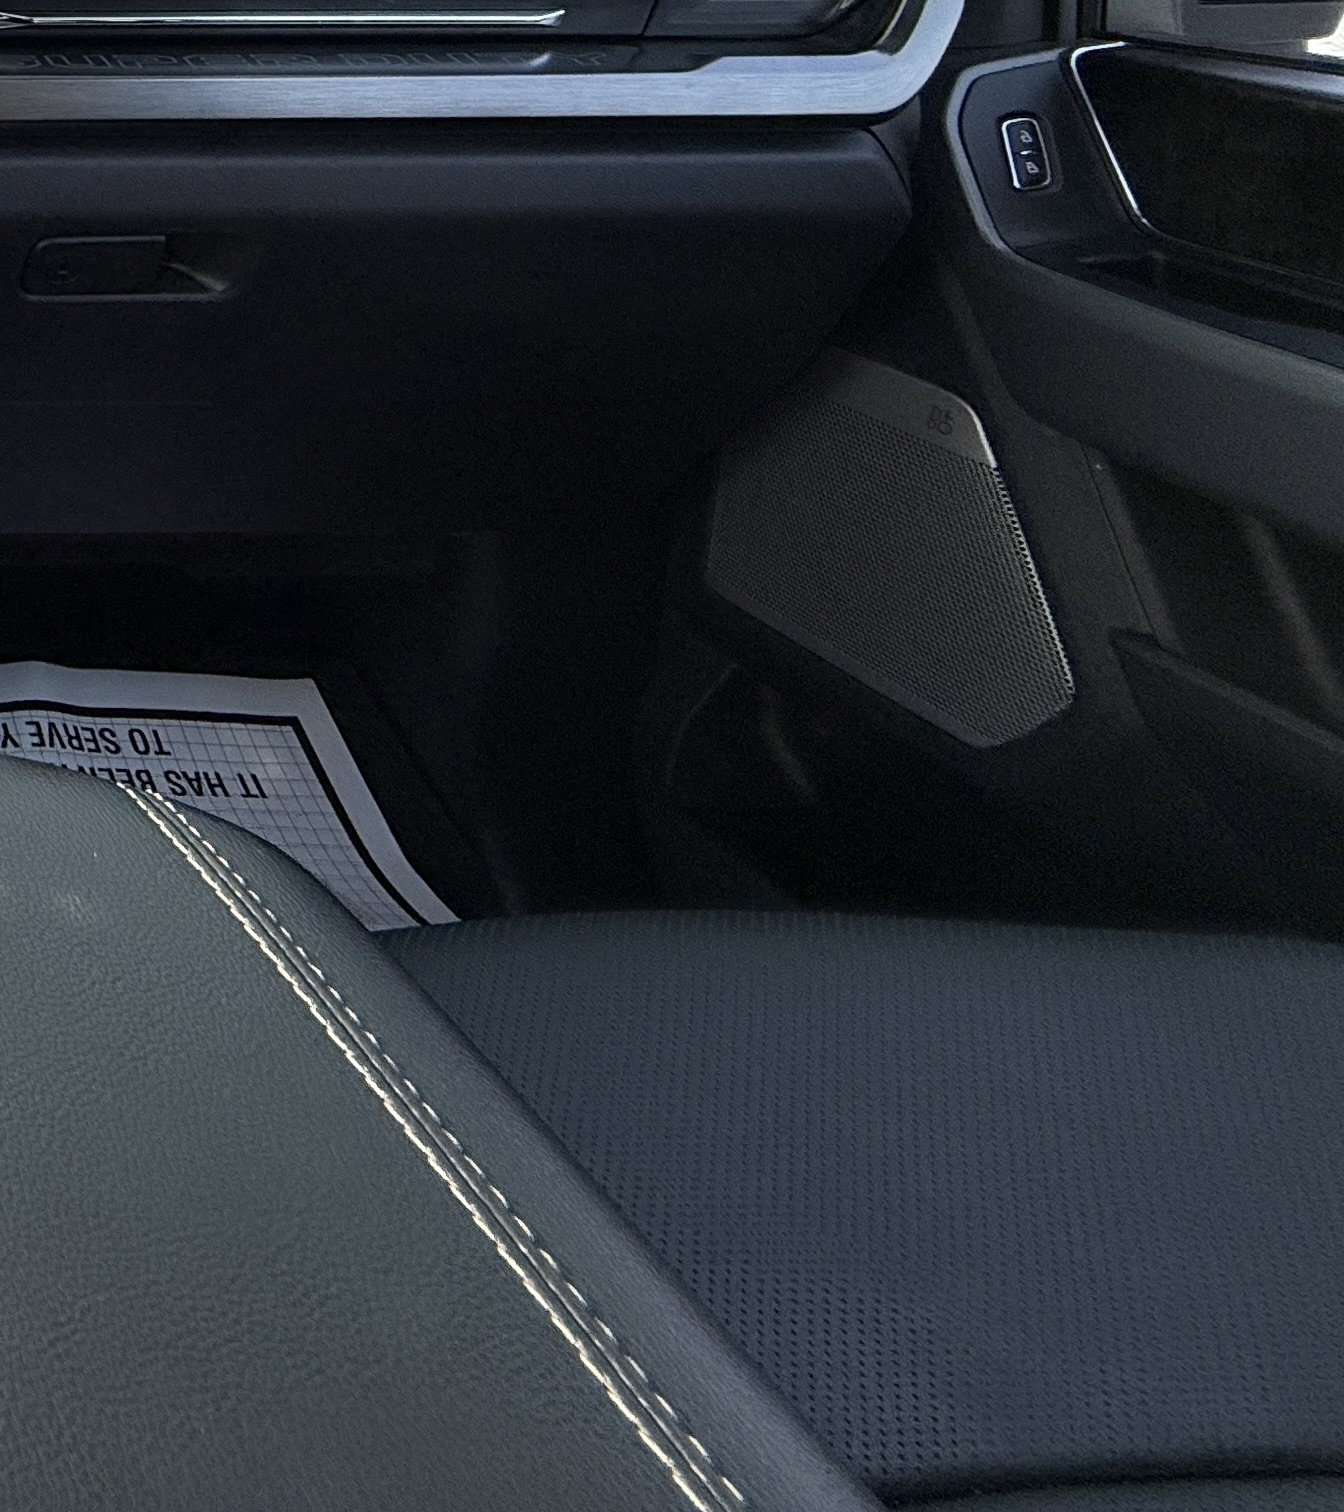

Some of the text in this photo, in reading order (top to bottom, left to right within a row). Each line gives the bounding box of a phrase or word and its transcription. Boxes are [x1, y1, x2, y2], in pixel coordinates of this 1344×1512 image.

[25, 719, 122, 755] SERVE
[127, 727, 172, 757] TO
[164, 769, 231, 798] HAS
[236, 772, 268, 799] IT
